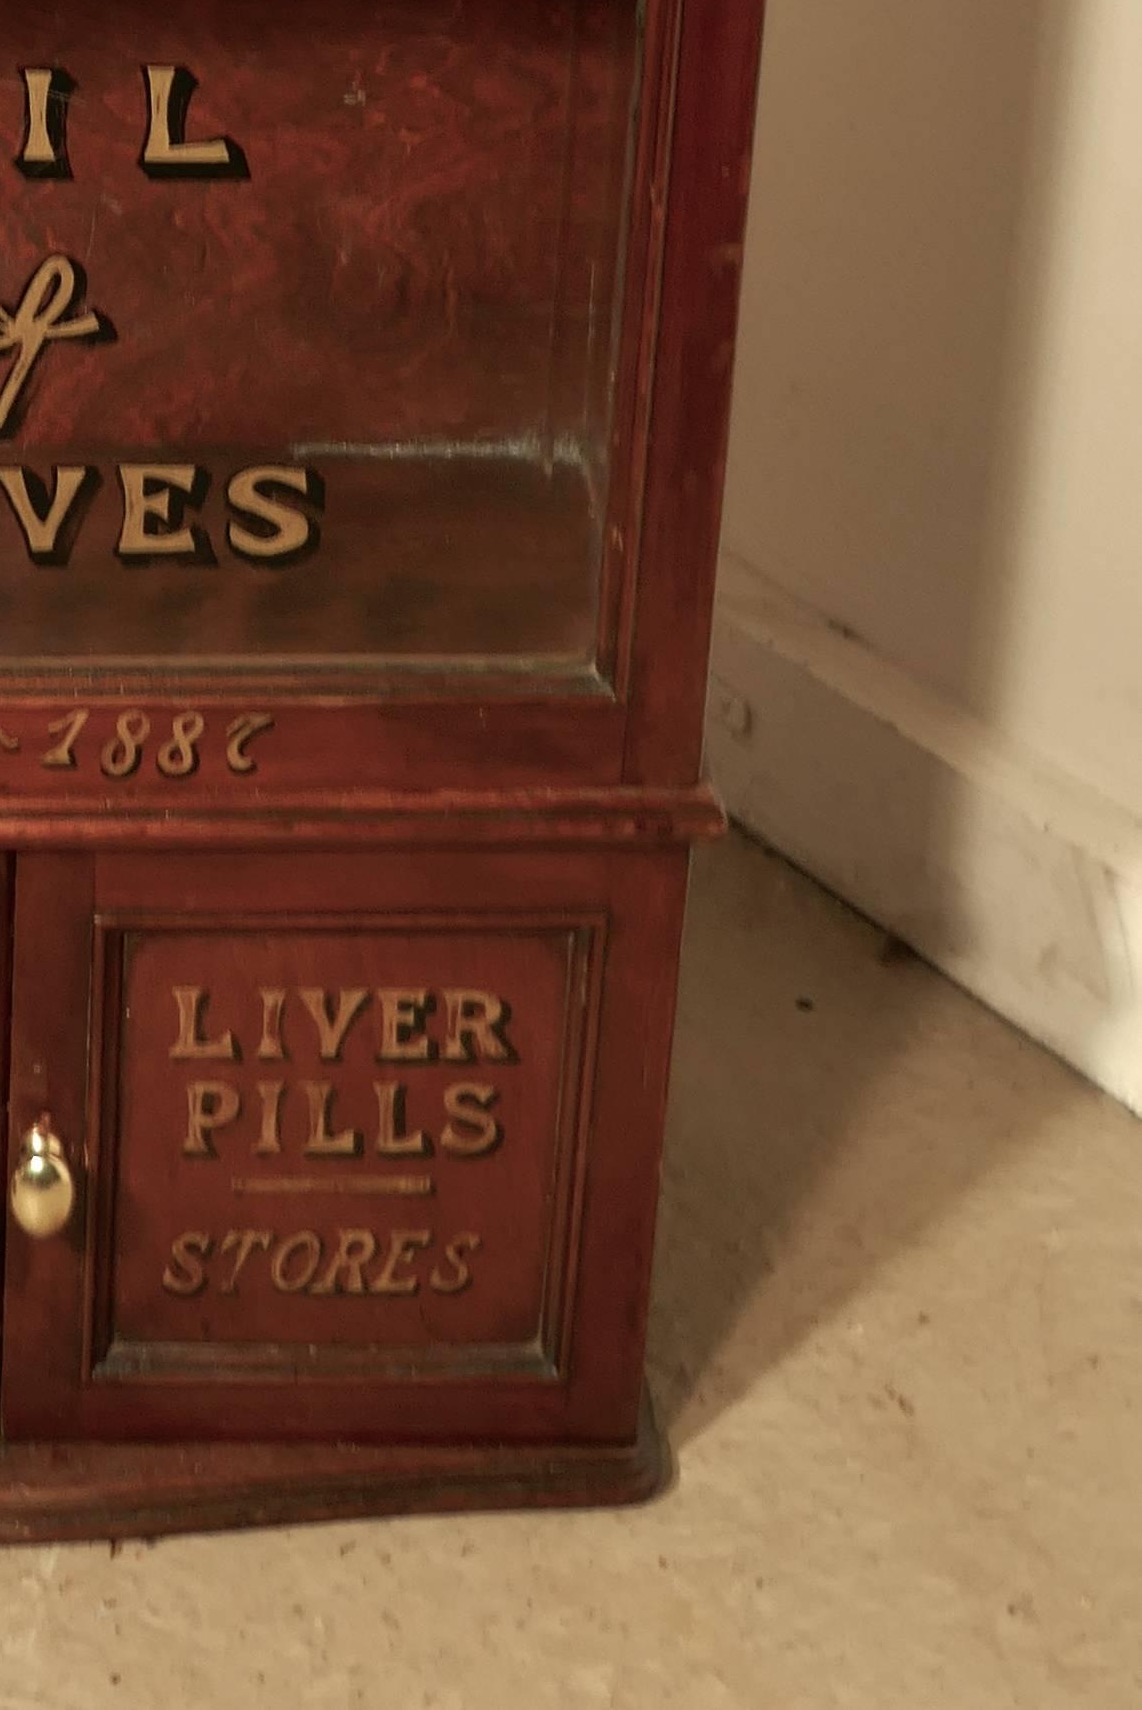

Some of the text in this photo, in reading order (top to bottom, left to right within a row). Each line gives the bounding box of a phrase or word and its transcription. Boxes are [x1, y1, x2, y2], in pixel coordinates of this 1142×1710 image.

[41, 711, 273, 778] 1887
[169, 985, 513, 1060] LIVER
[183, 1080, 500, 1156] PILLS
[162, 1228, 482, 1292] STORES
